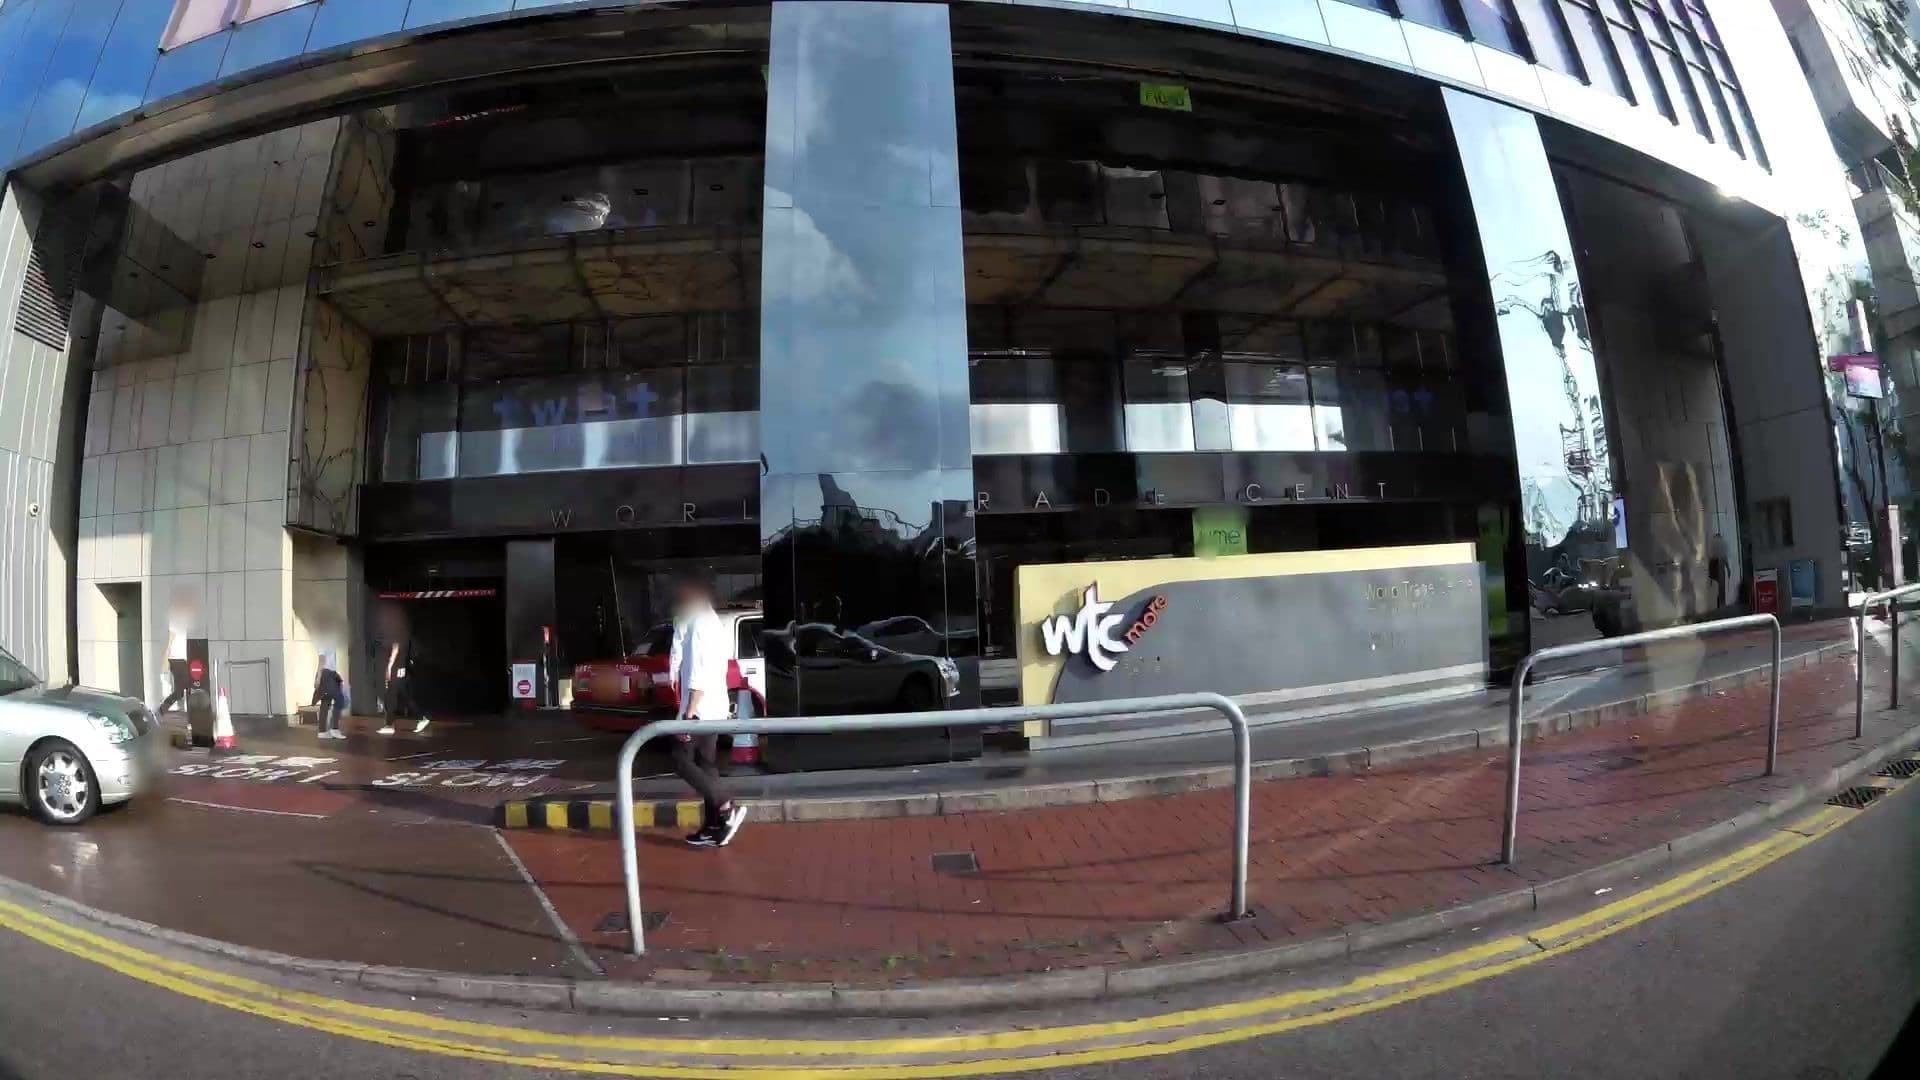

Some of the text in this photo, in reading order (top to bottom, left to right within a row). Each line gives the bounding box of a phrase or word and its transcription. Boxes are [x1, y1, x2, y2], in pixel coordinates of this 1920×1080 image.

[550, 482, 1388, 529] WORL RADE CENT
[1042, 581, 1169, 671] wtc more
